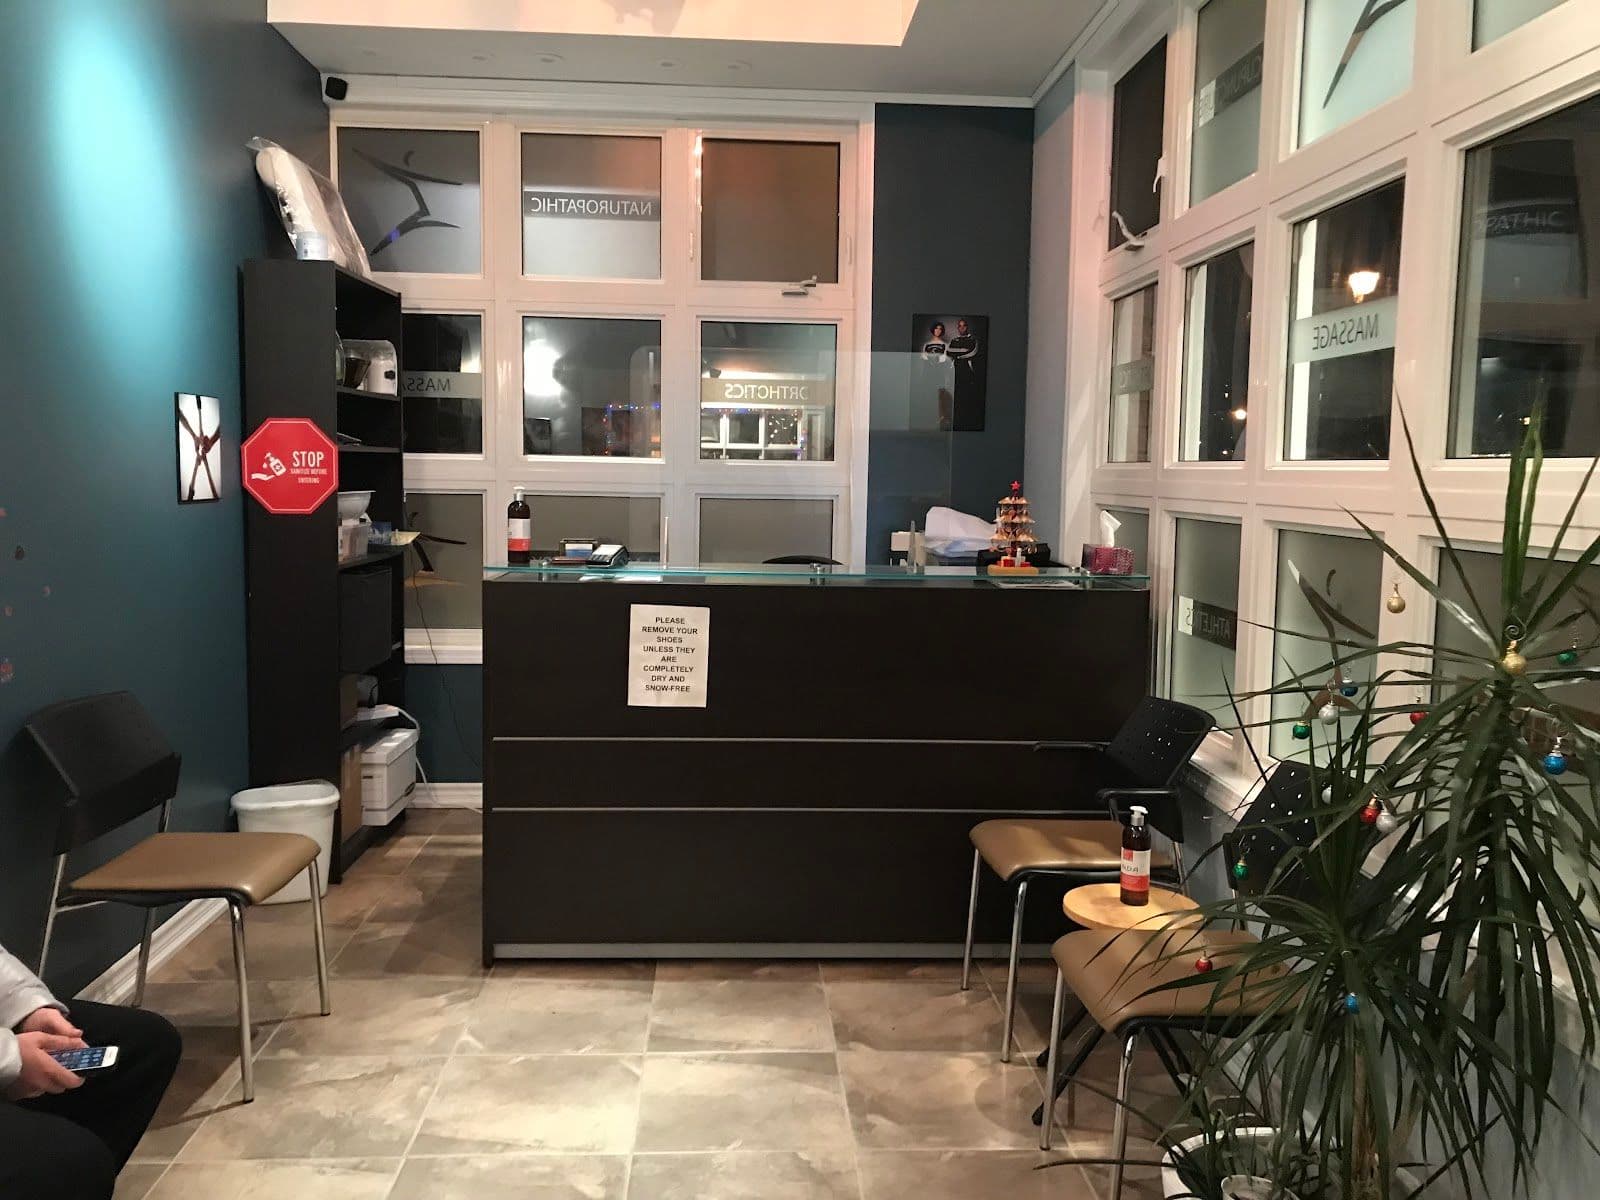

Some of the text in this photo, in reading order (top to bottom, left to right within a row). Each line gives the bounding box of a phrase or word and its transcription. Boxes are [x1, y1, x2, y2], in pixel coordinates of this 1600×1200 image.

[292, 450, 325, 468] STOP
[655, 616, 686, 624] PLEASE
[641, 626, 675, 634] REMOVE
[643, 645, 674, 653] UNLESS
[660, 655, 677, 663] ARE
[643, 665, 694, 673] COMPLETELY
[645, 684, 691, 692] SNOW-FREE
